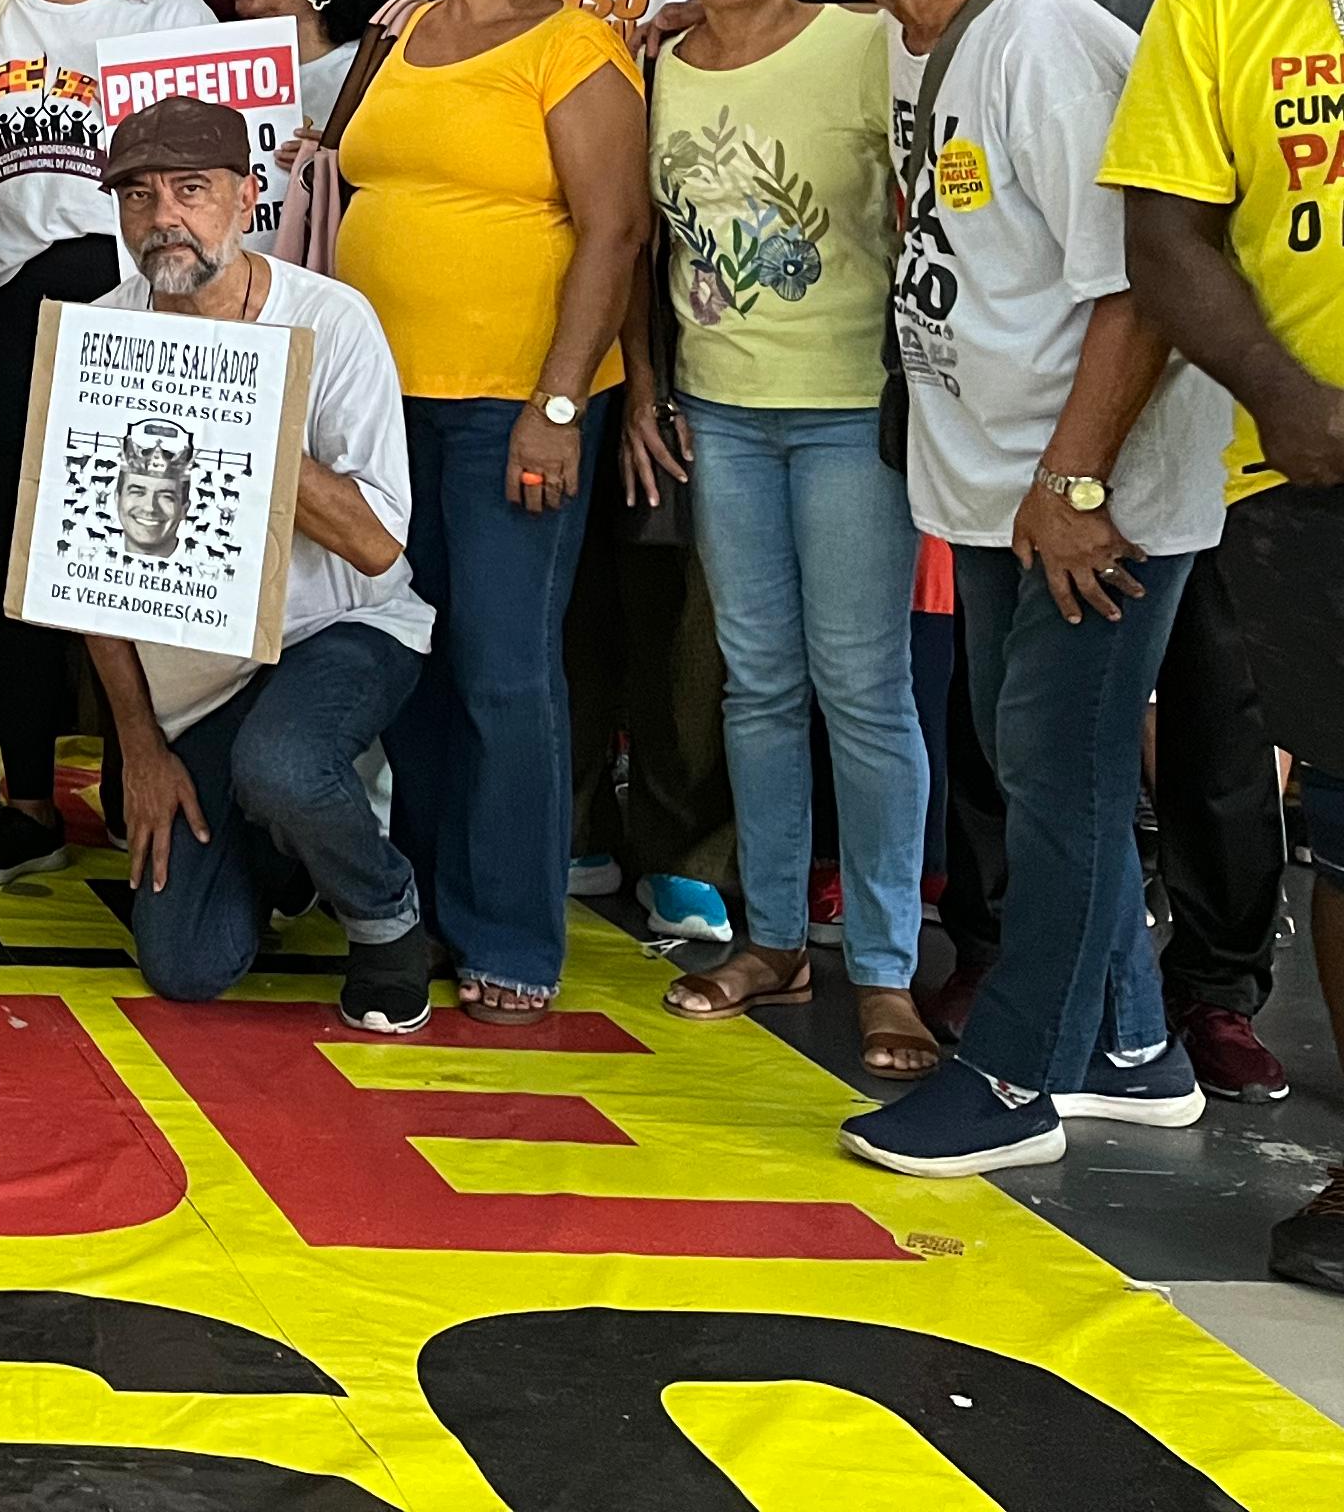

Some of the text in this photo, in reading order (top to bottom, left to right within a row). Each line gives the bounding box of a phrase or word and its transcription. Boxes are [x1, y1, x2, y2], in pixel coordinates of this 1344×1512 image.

[107, 57, 291, 117] PREFEITO,
[260, 123, 276, 151] O
[0, 151, 28, 164] COLETIVO
[20, 159, 55, 170] MUNICIPAL
[65, 161, 102, 177] SALVADOR
[157, 342, 176, 376] DE
[180, 345, 259, 388] SALVADOR
[80, 370, 257, 405] DEU UM GOLPE NAS
[78, 390, 252, 426] PROFESSORAS(ES)
[67, 562, 218, 601] COM SEU REBANHO
[50, 584, 228, 628] DE VEREADORES(AS)!
